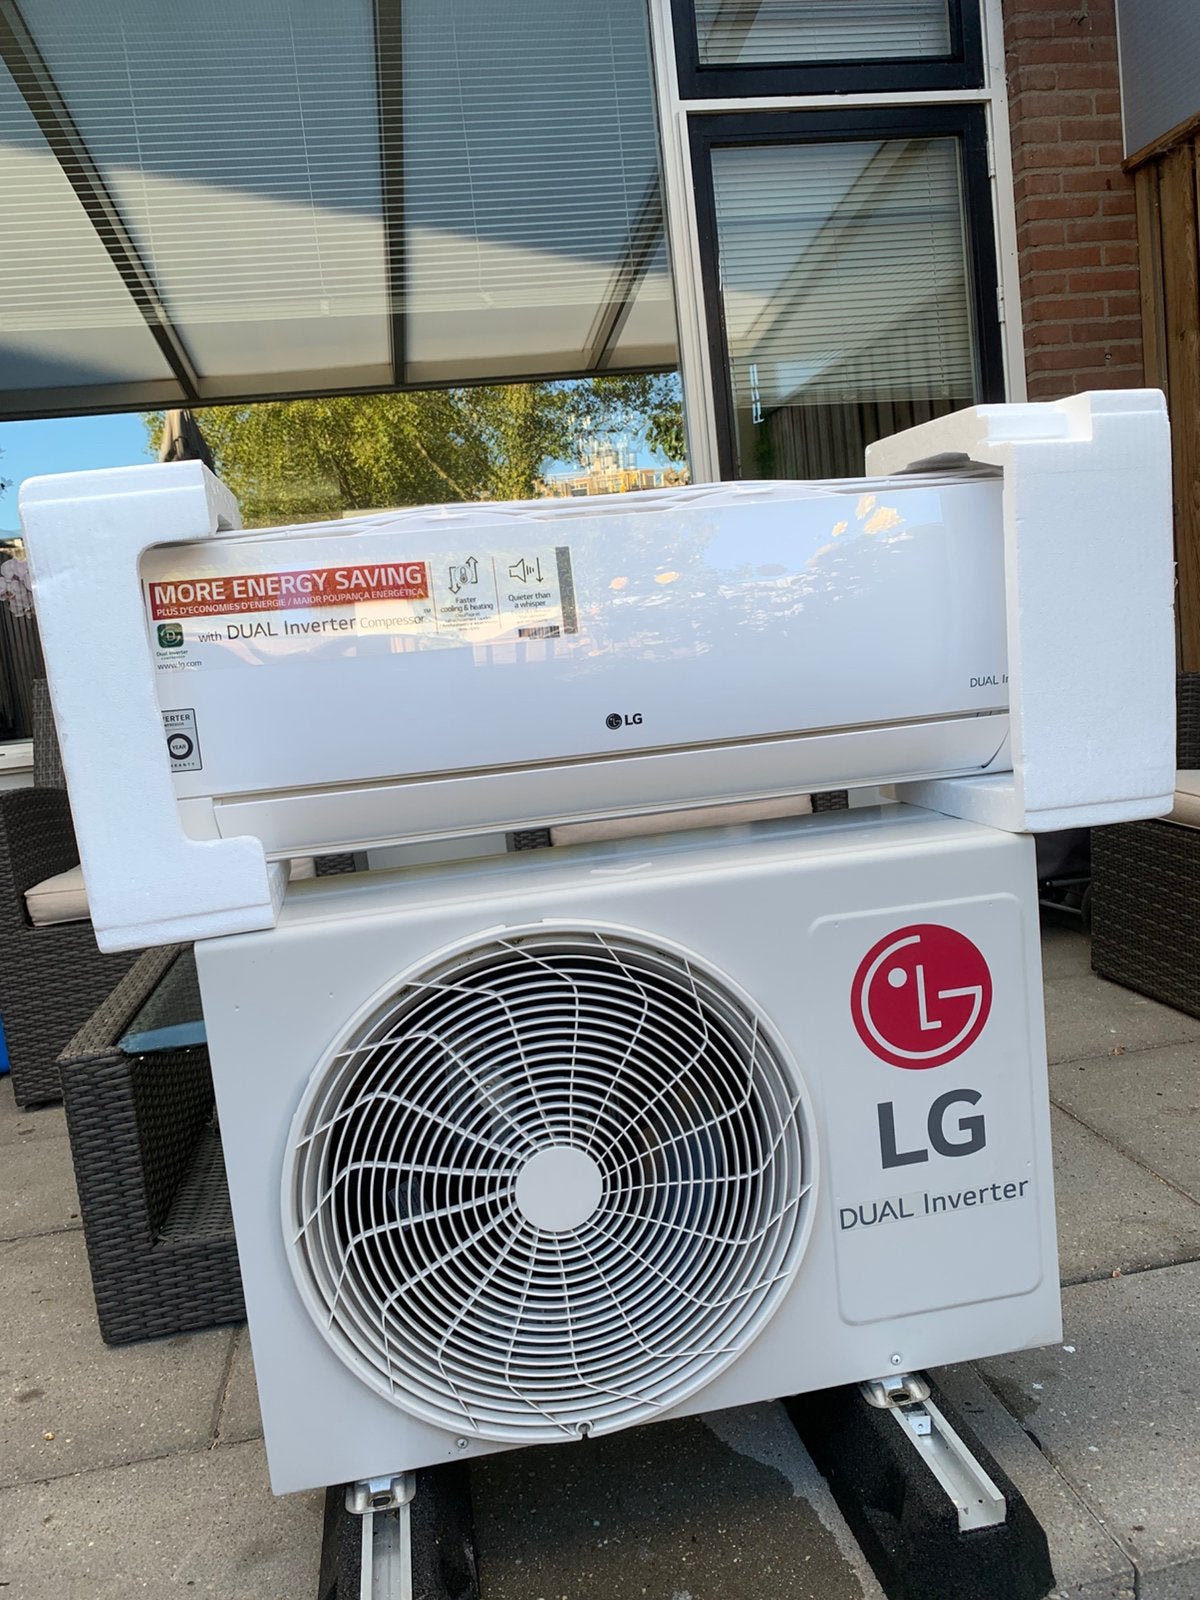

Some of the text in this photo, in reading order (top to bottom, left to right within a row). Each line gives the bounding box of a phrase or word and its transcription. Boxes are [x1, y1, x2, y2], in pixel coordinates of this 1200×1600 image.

[154, 565, 422, 605] MORE ENERGY SAVING
[156, 608, 178, 616] PLUS
[293, 596, 321, 605] MAIOR
[323, 591, 371, 603] POUPANÇA
[508, 593, 533, 603] Quieter
[520, 600, 546, 608] whisper
[441, 605, 463, 613] cooling
[470, 603, 494, 611] heating
[198, 631, 222, 642] with
[227, 621, 279, 640] DUAL
[284, 617, 356, 636] Inverter
[360, 616, 424, 629] Compressor
[157, 661, 202, 670] www.lg.com
[970, 675, 999, 688] DUAL
[624, 712, 643, 726] LG
[877, 1088, 986, 1170] LG
[839, 1178, 1030, 1231] DUAL Inverter
